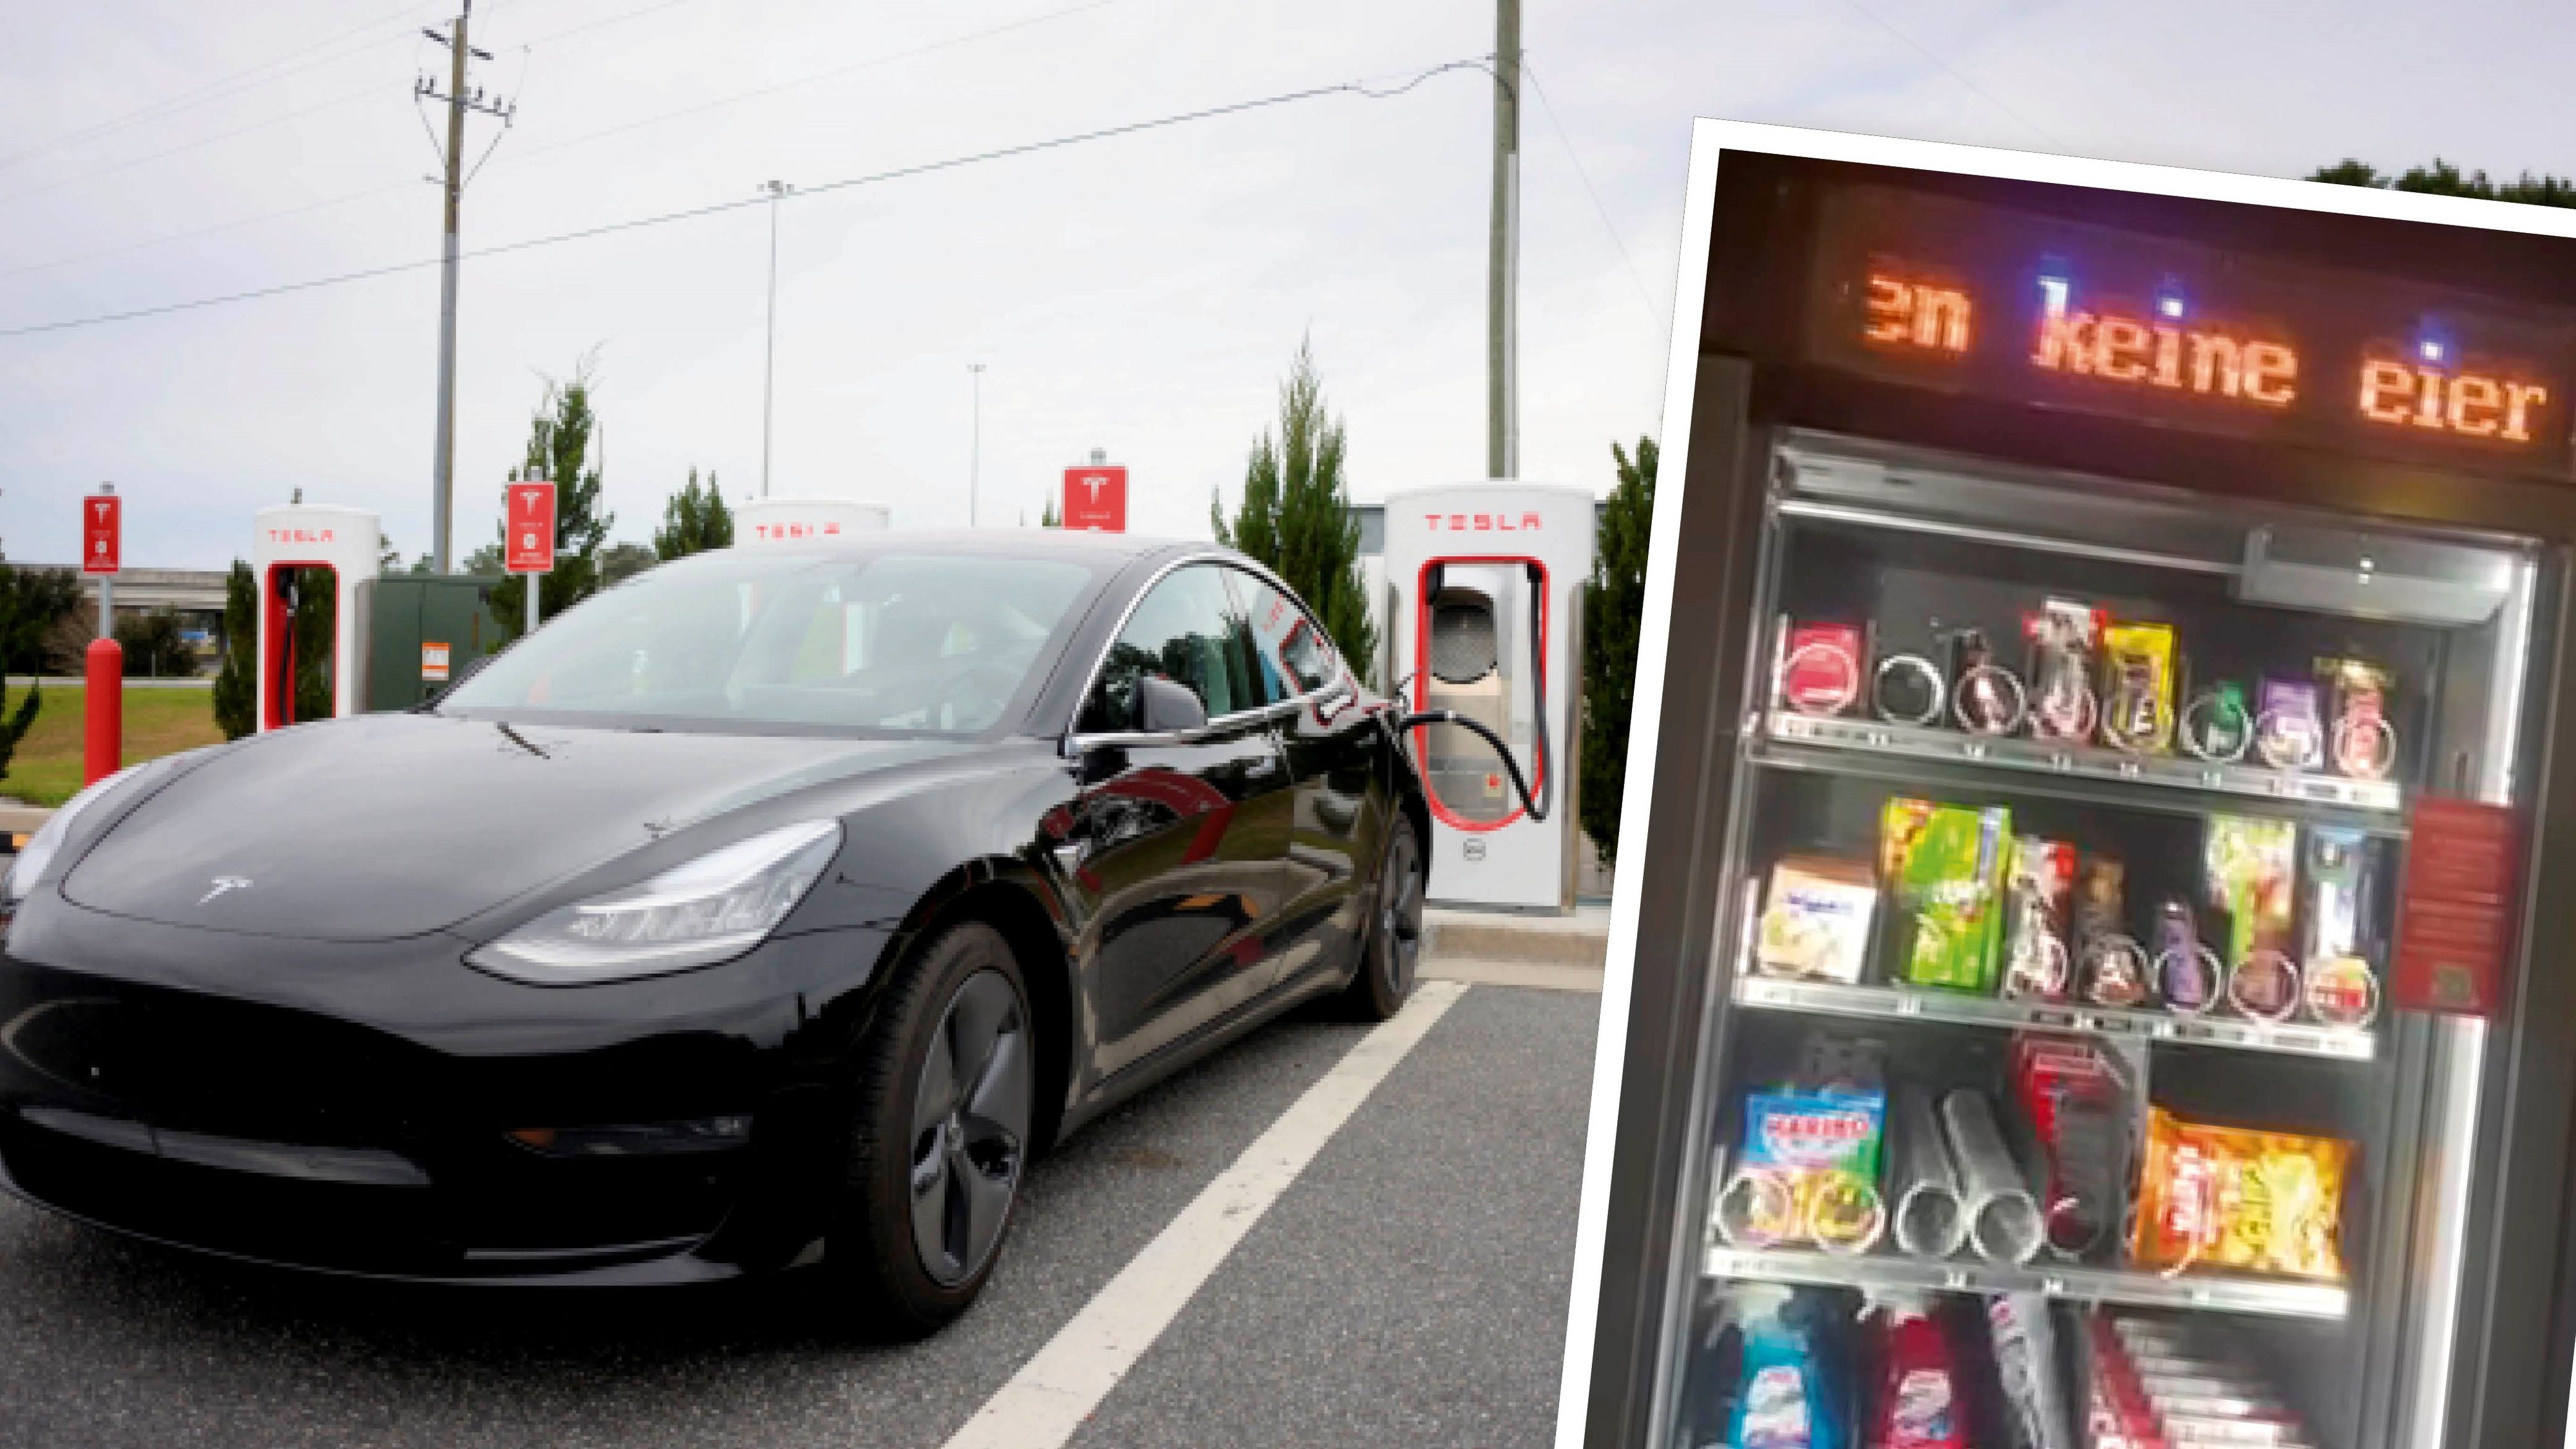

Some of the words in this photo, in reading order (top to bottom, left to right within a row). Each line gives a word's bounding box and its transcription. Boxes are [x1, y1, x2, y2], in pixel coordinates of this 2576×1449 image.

[2034, 274, 2298, 408] keine
[2357, 340, 2546, 442] eier
[1425, 513, 1542, 531] TESLA
[267, 528, 336, 543] TESLA
